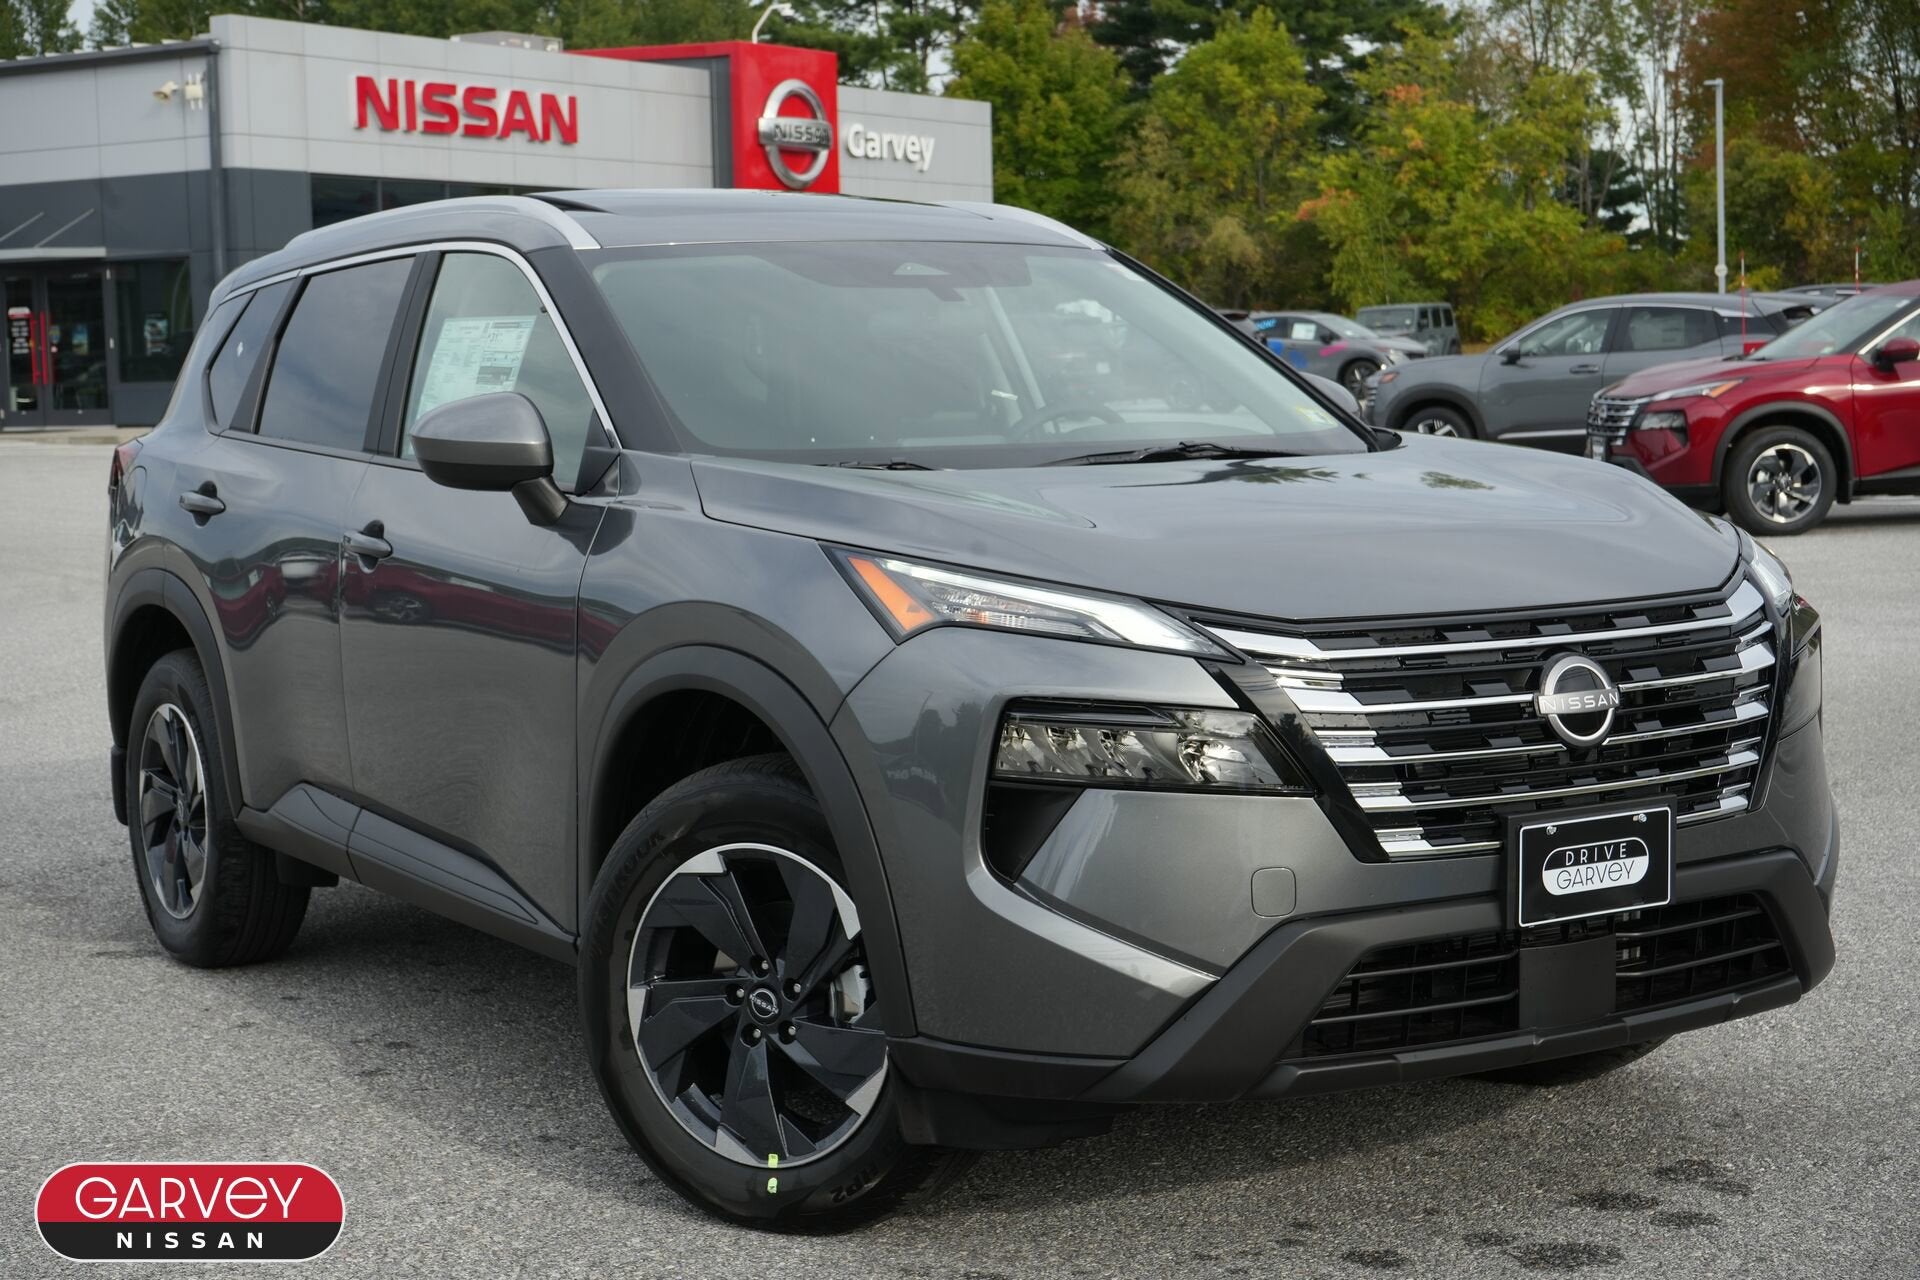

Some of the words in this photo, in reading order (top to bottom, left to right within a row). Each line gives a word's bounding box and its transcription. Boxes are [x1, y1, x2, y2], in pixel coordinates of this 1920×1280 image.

[355, 75, 578, 144] NISSAN
[774, 124, 832, 144] NISSAN
[847, 123, 935, 172] Garvey
[1542, 692, 1619, 711] NISSAN
[1565, 842, 1627, 866] DRIVE
[749, 994, 779, 1014] NISSAN
